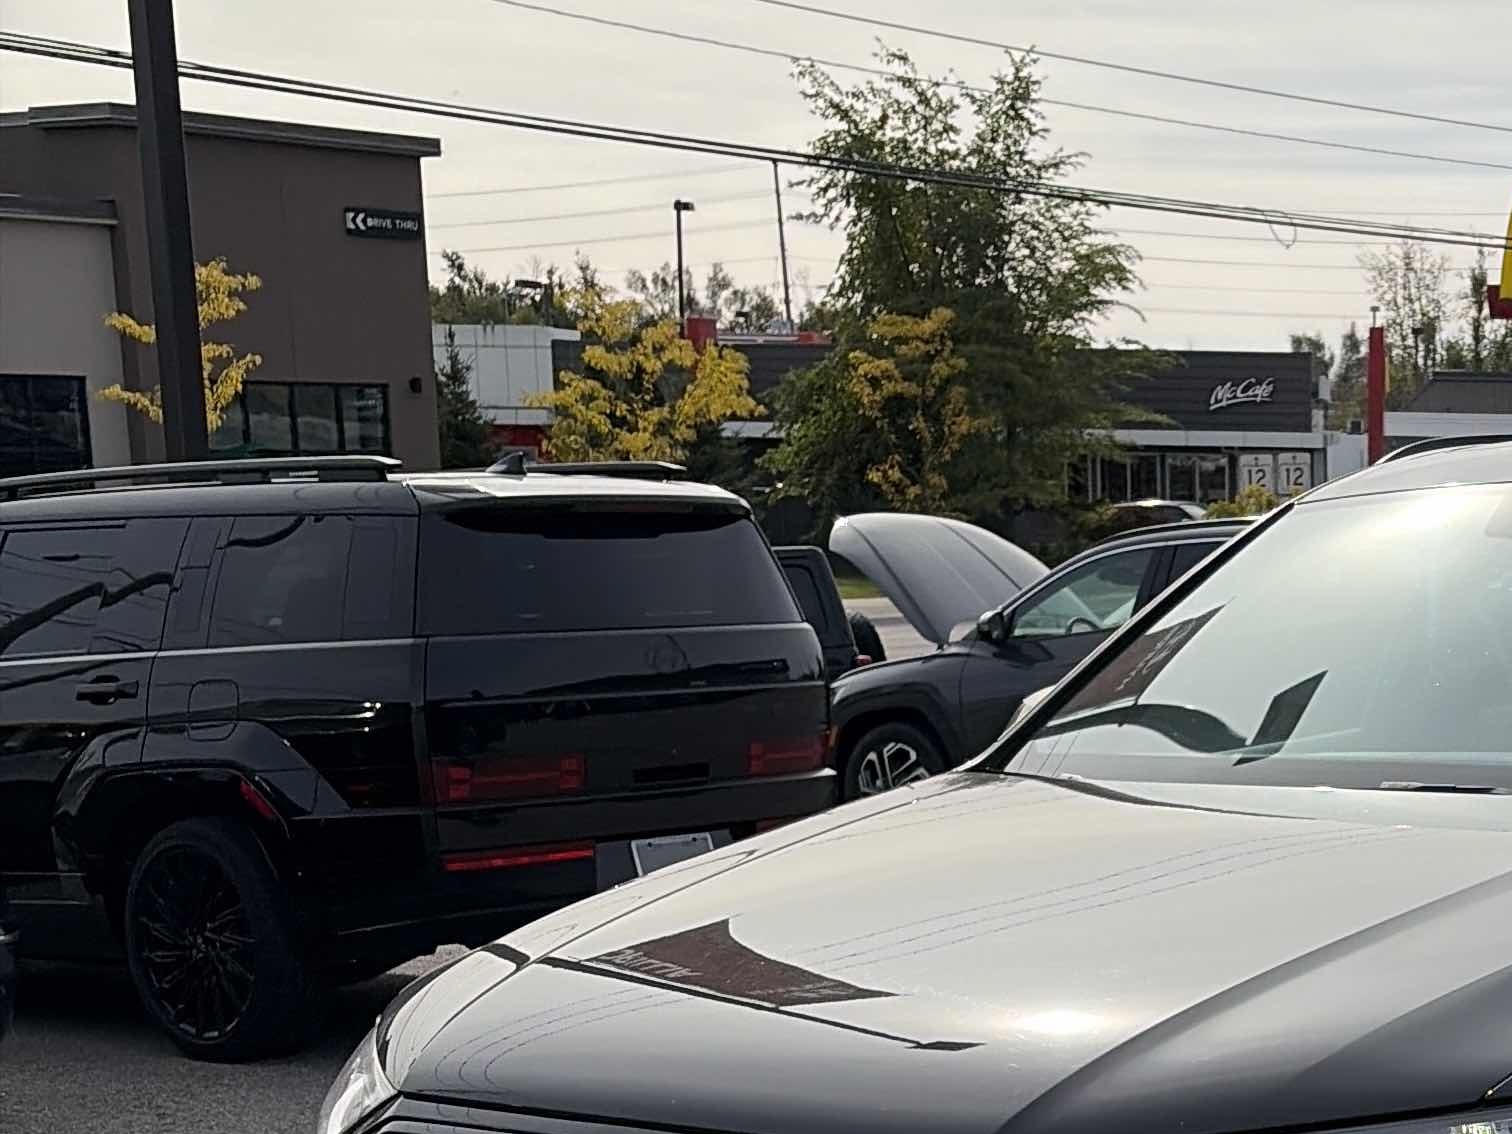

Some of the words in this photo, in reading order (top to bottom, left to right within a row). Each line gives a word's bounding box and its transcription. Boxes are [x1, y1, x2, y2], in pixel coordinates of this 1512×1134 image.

[366, 217, 392, 229] DRIVE
[395, 219, 419, 231] THRU
[1284, 467, 1304, 486] 12
